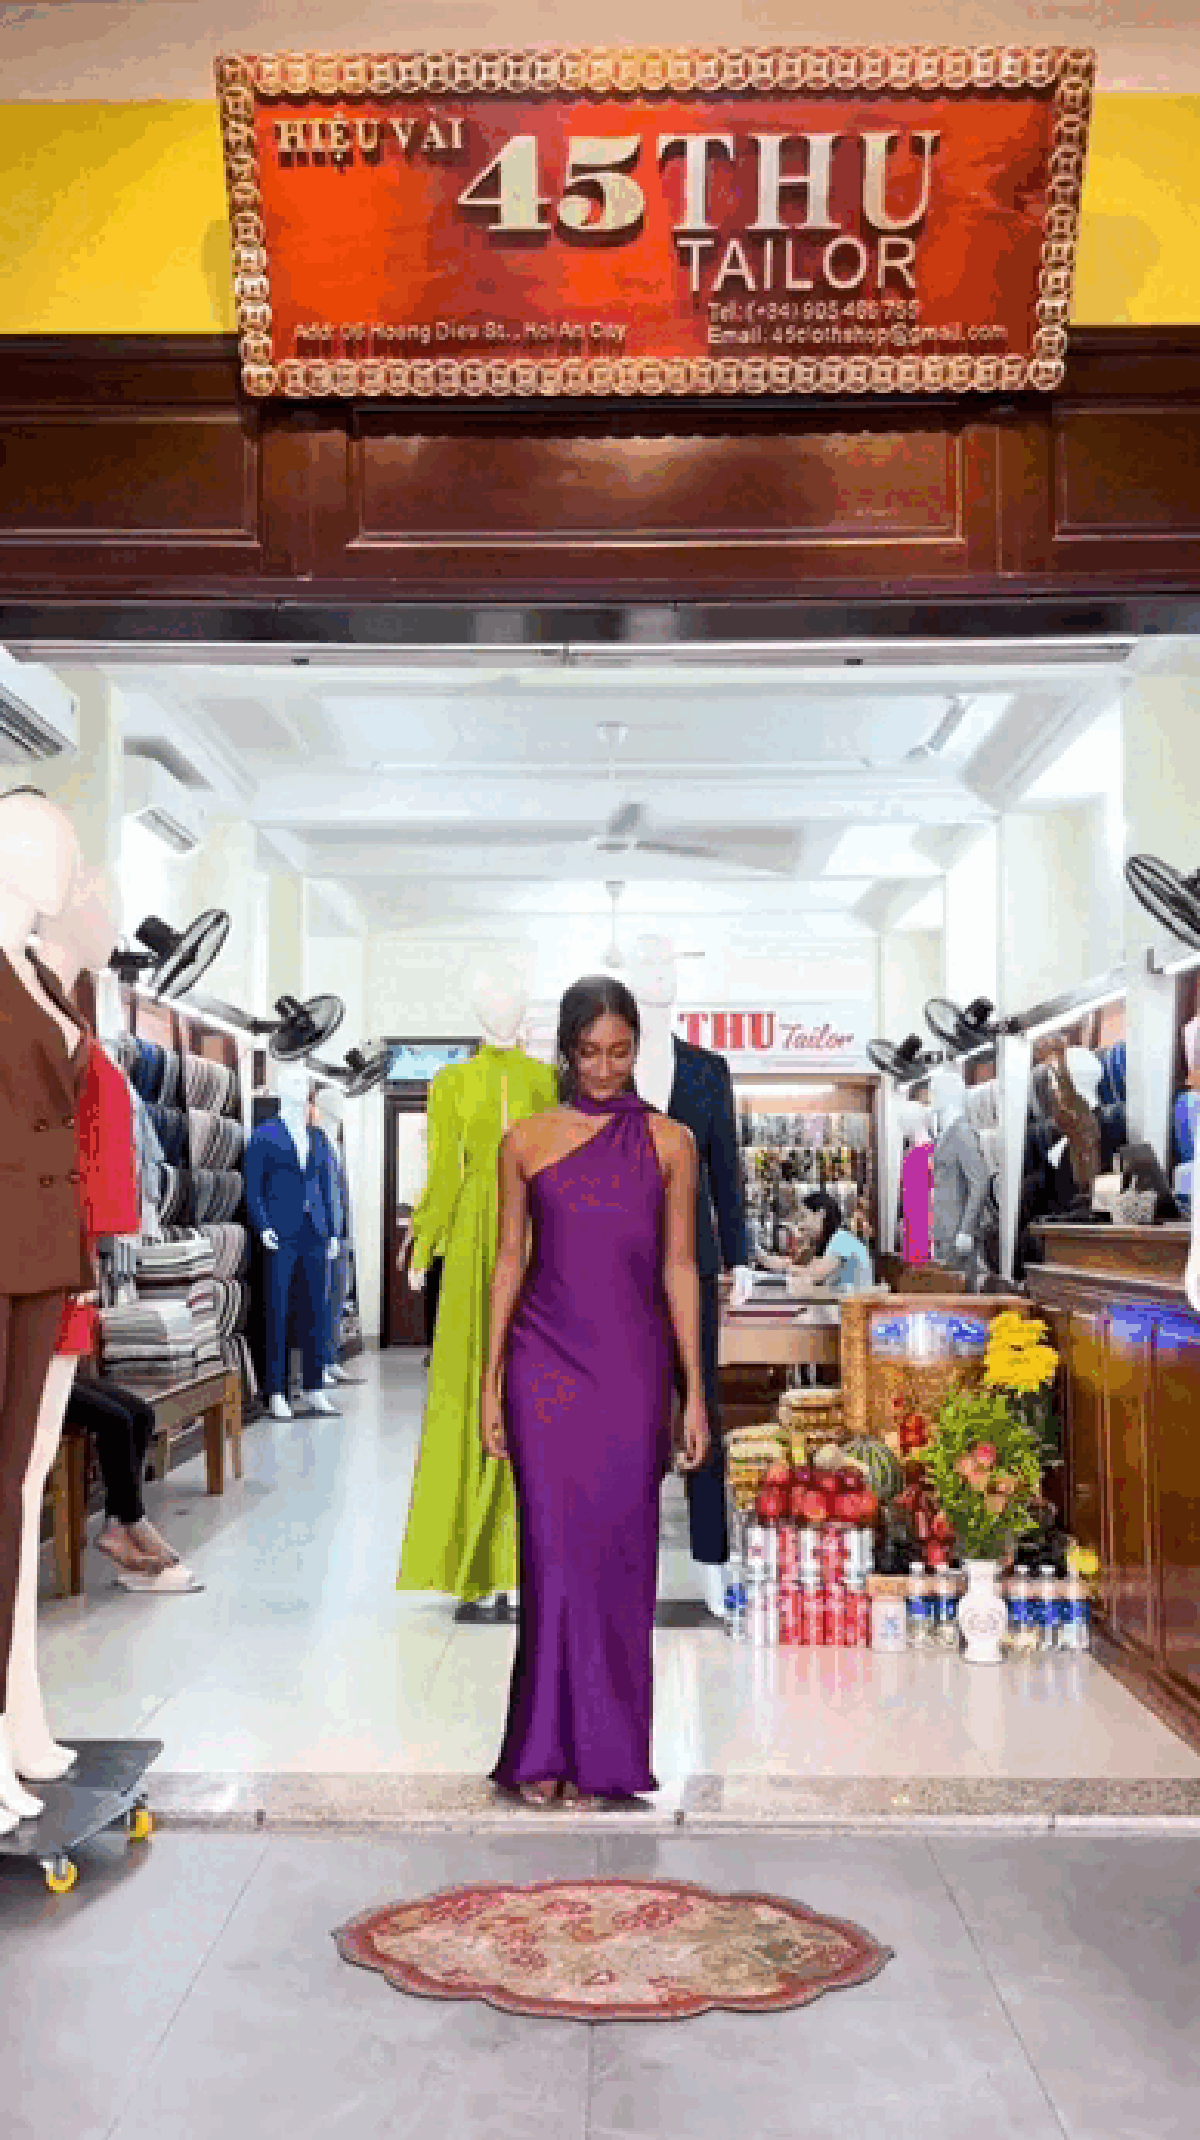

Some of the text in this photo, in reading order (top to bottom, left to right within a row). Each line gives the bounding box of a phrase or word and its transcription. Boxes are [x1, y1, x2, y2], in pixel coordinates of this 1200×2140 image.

[676, 236, 917, 292] TAILOR
[677, 1012, 854, 1050] THU Tailor
